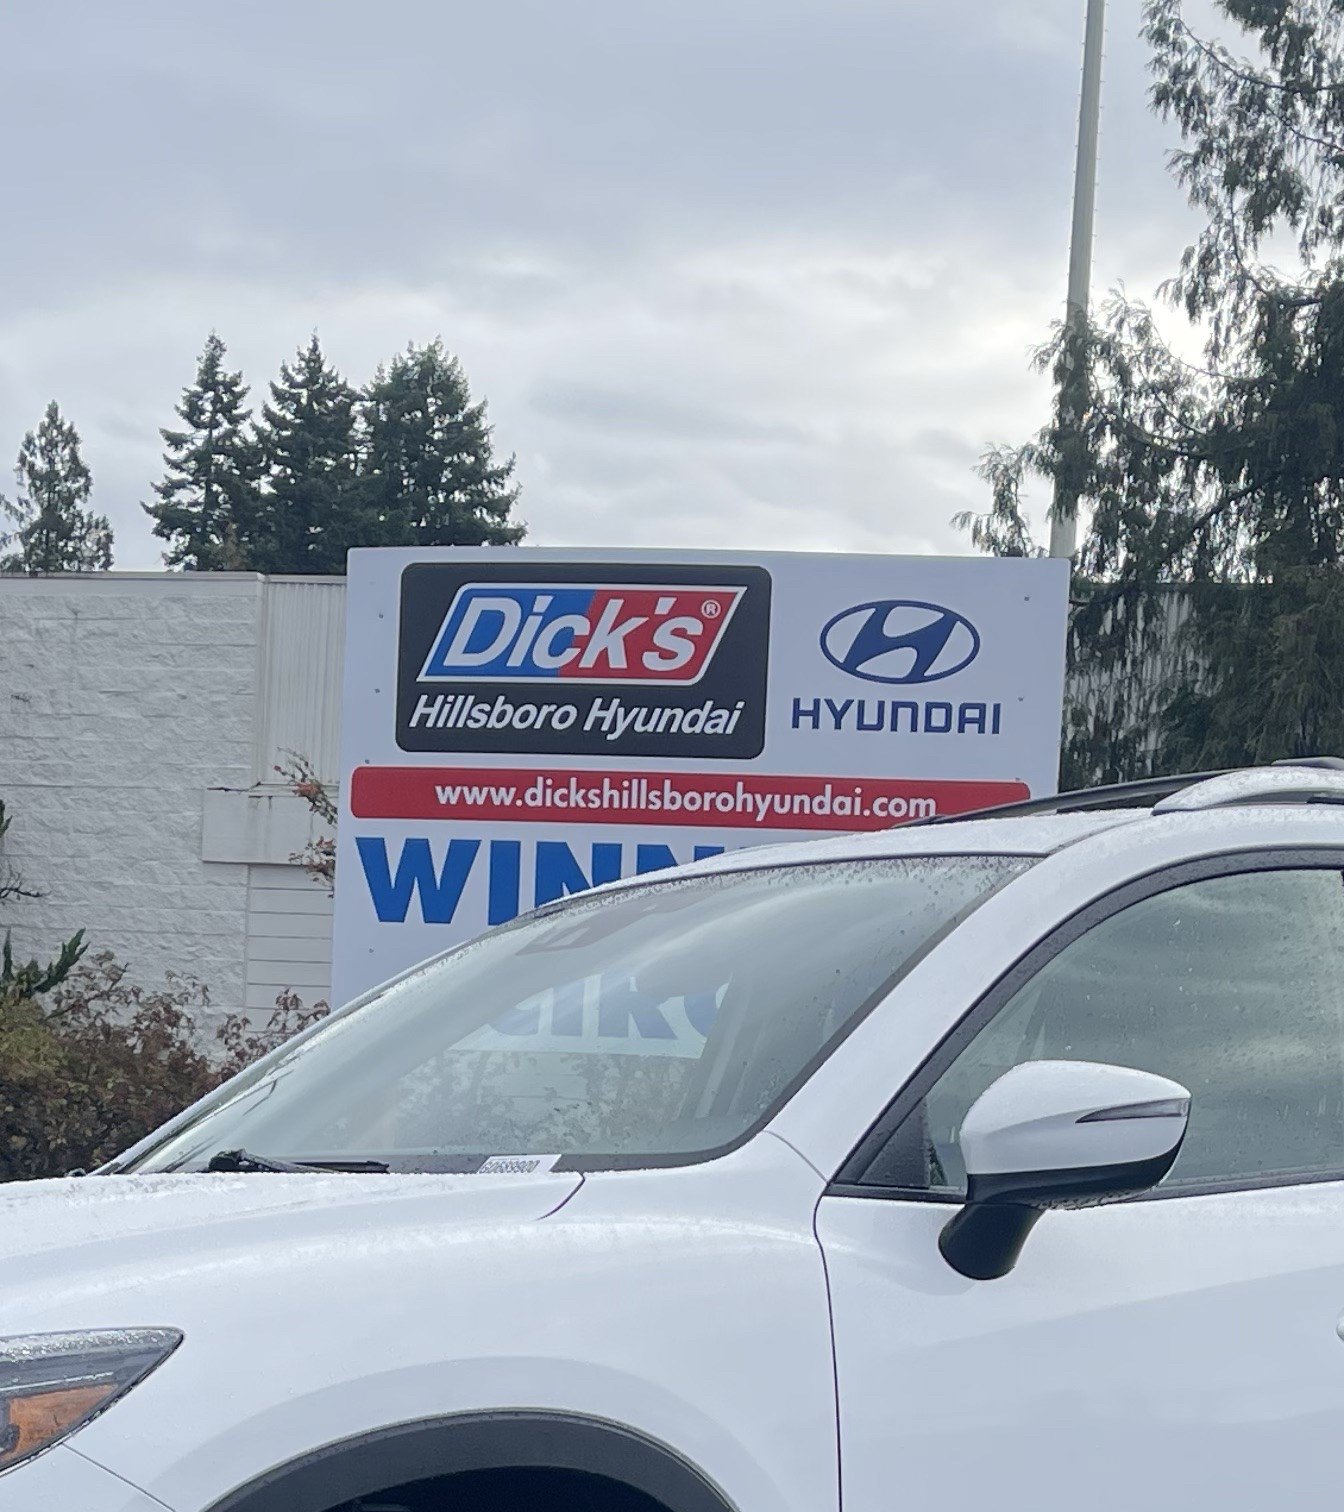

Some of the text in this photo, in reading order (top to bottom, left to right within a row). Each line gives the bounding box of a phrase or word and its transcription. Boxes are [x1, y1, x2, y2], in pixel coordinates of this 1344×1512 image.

[408, 694, 746, 741] Hillsboro Hyundai
[791, 697, 1002, 735] HYUNDAI
[434, 776, 937, 822] www.dickshillsborohyundai.com
